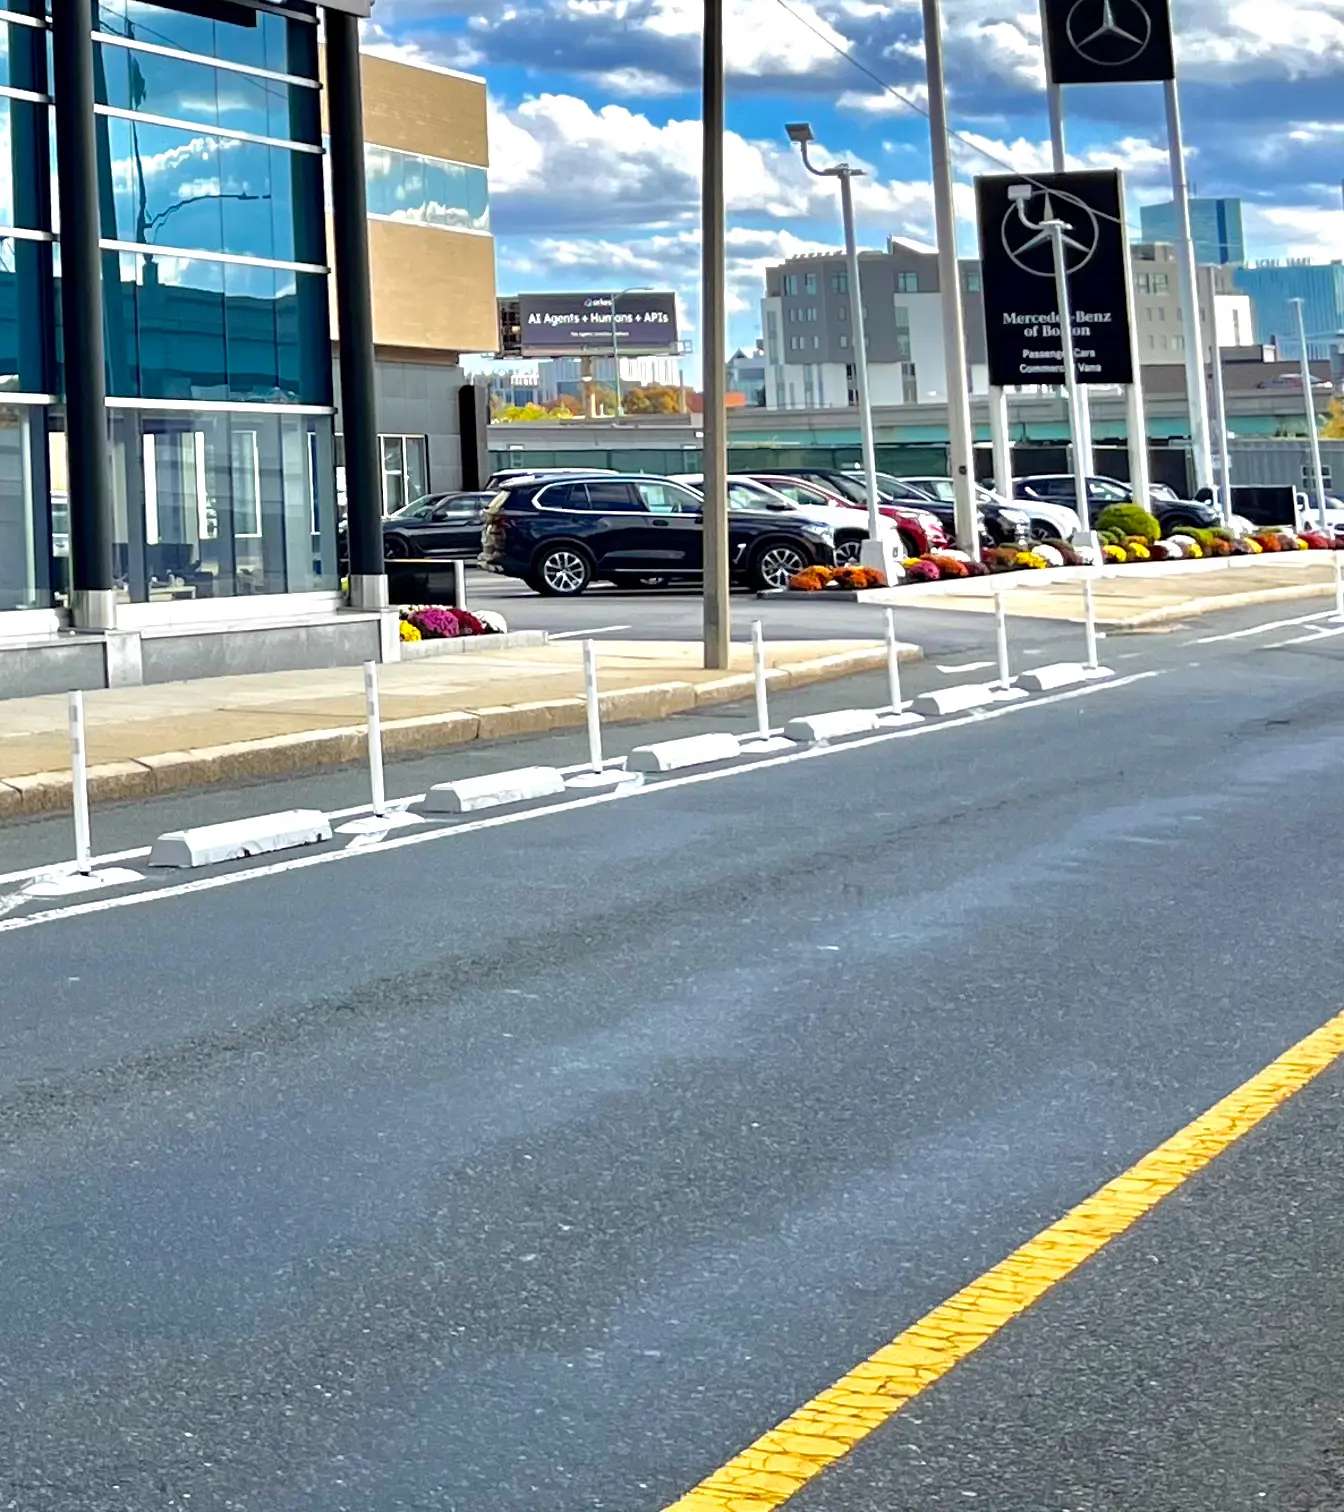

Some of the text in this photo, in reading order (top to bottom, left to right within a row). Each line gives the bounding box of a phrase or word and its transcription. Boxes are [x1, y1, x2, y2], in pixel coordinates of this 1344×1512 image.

[527, 313, 541, 325] AI
[543, 313, 580, 327] Agents
[643, 312, 670, 324] APIs
[1002, 311, 1112, 325] Mercede-Benz
[1023, 324, 1091, 338] of Boon
